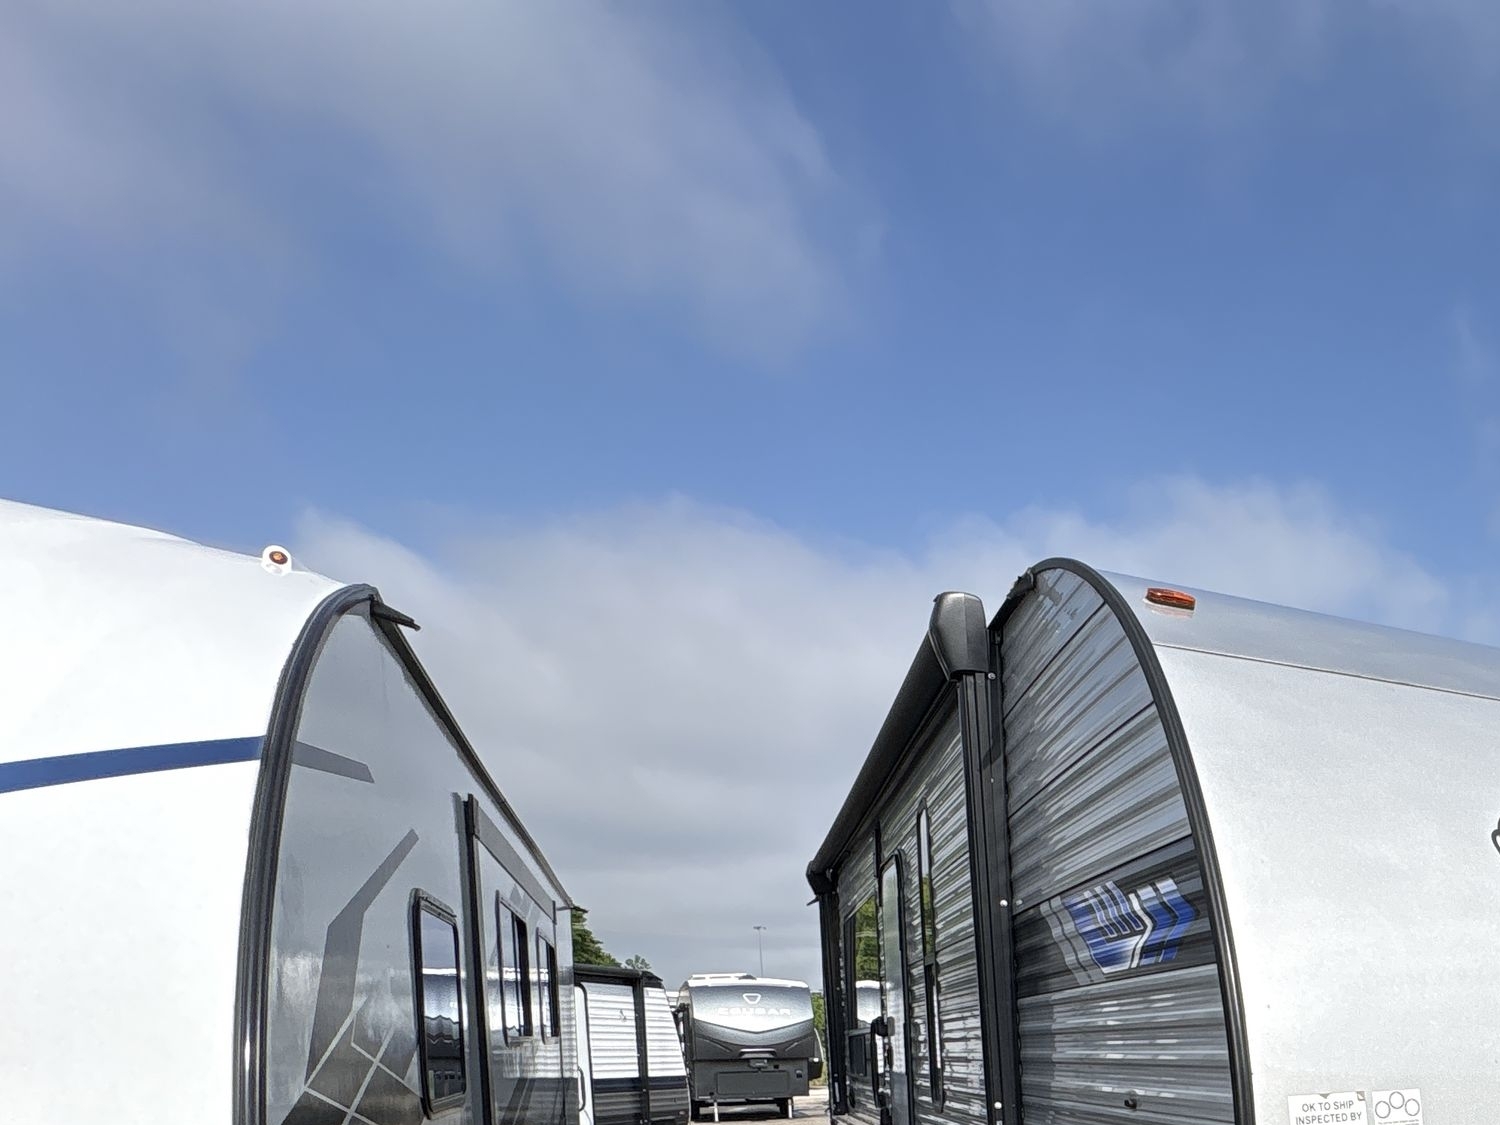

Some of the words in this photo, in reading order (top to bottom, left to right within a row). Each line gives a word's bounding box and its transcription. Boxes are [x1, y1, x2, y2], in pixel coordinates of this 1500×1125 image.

[1301, 1103, 1316, 1113] OK
[1318, 1101, 1331, 1111] TO
[1333, 1100, 1355, 1110] SHIP
[1295, 1112, 1348, 1125] INSPECTED
[1350, 1111, 1363, 1122] BY
